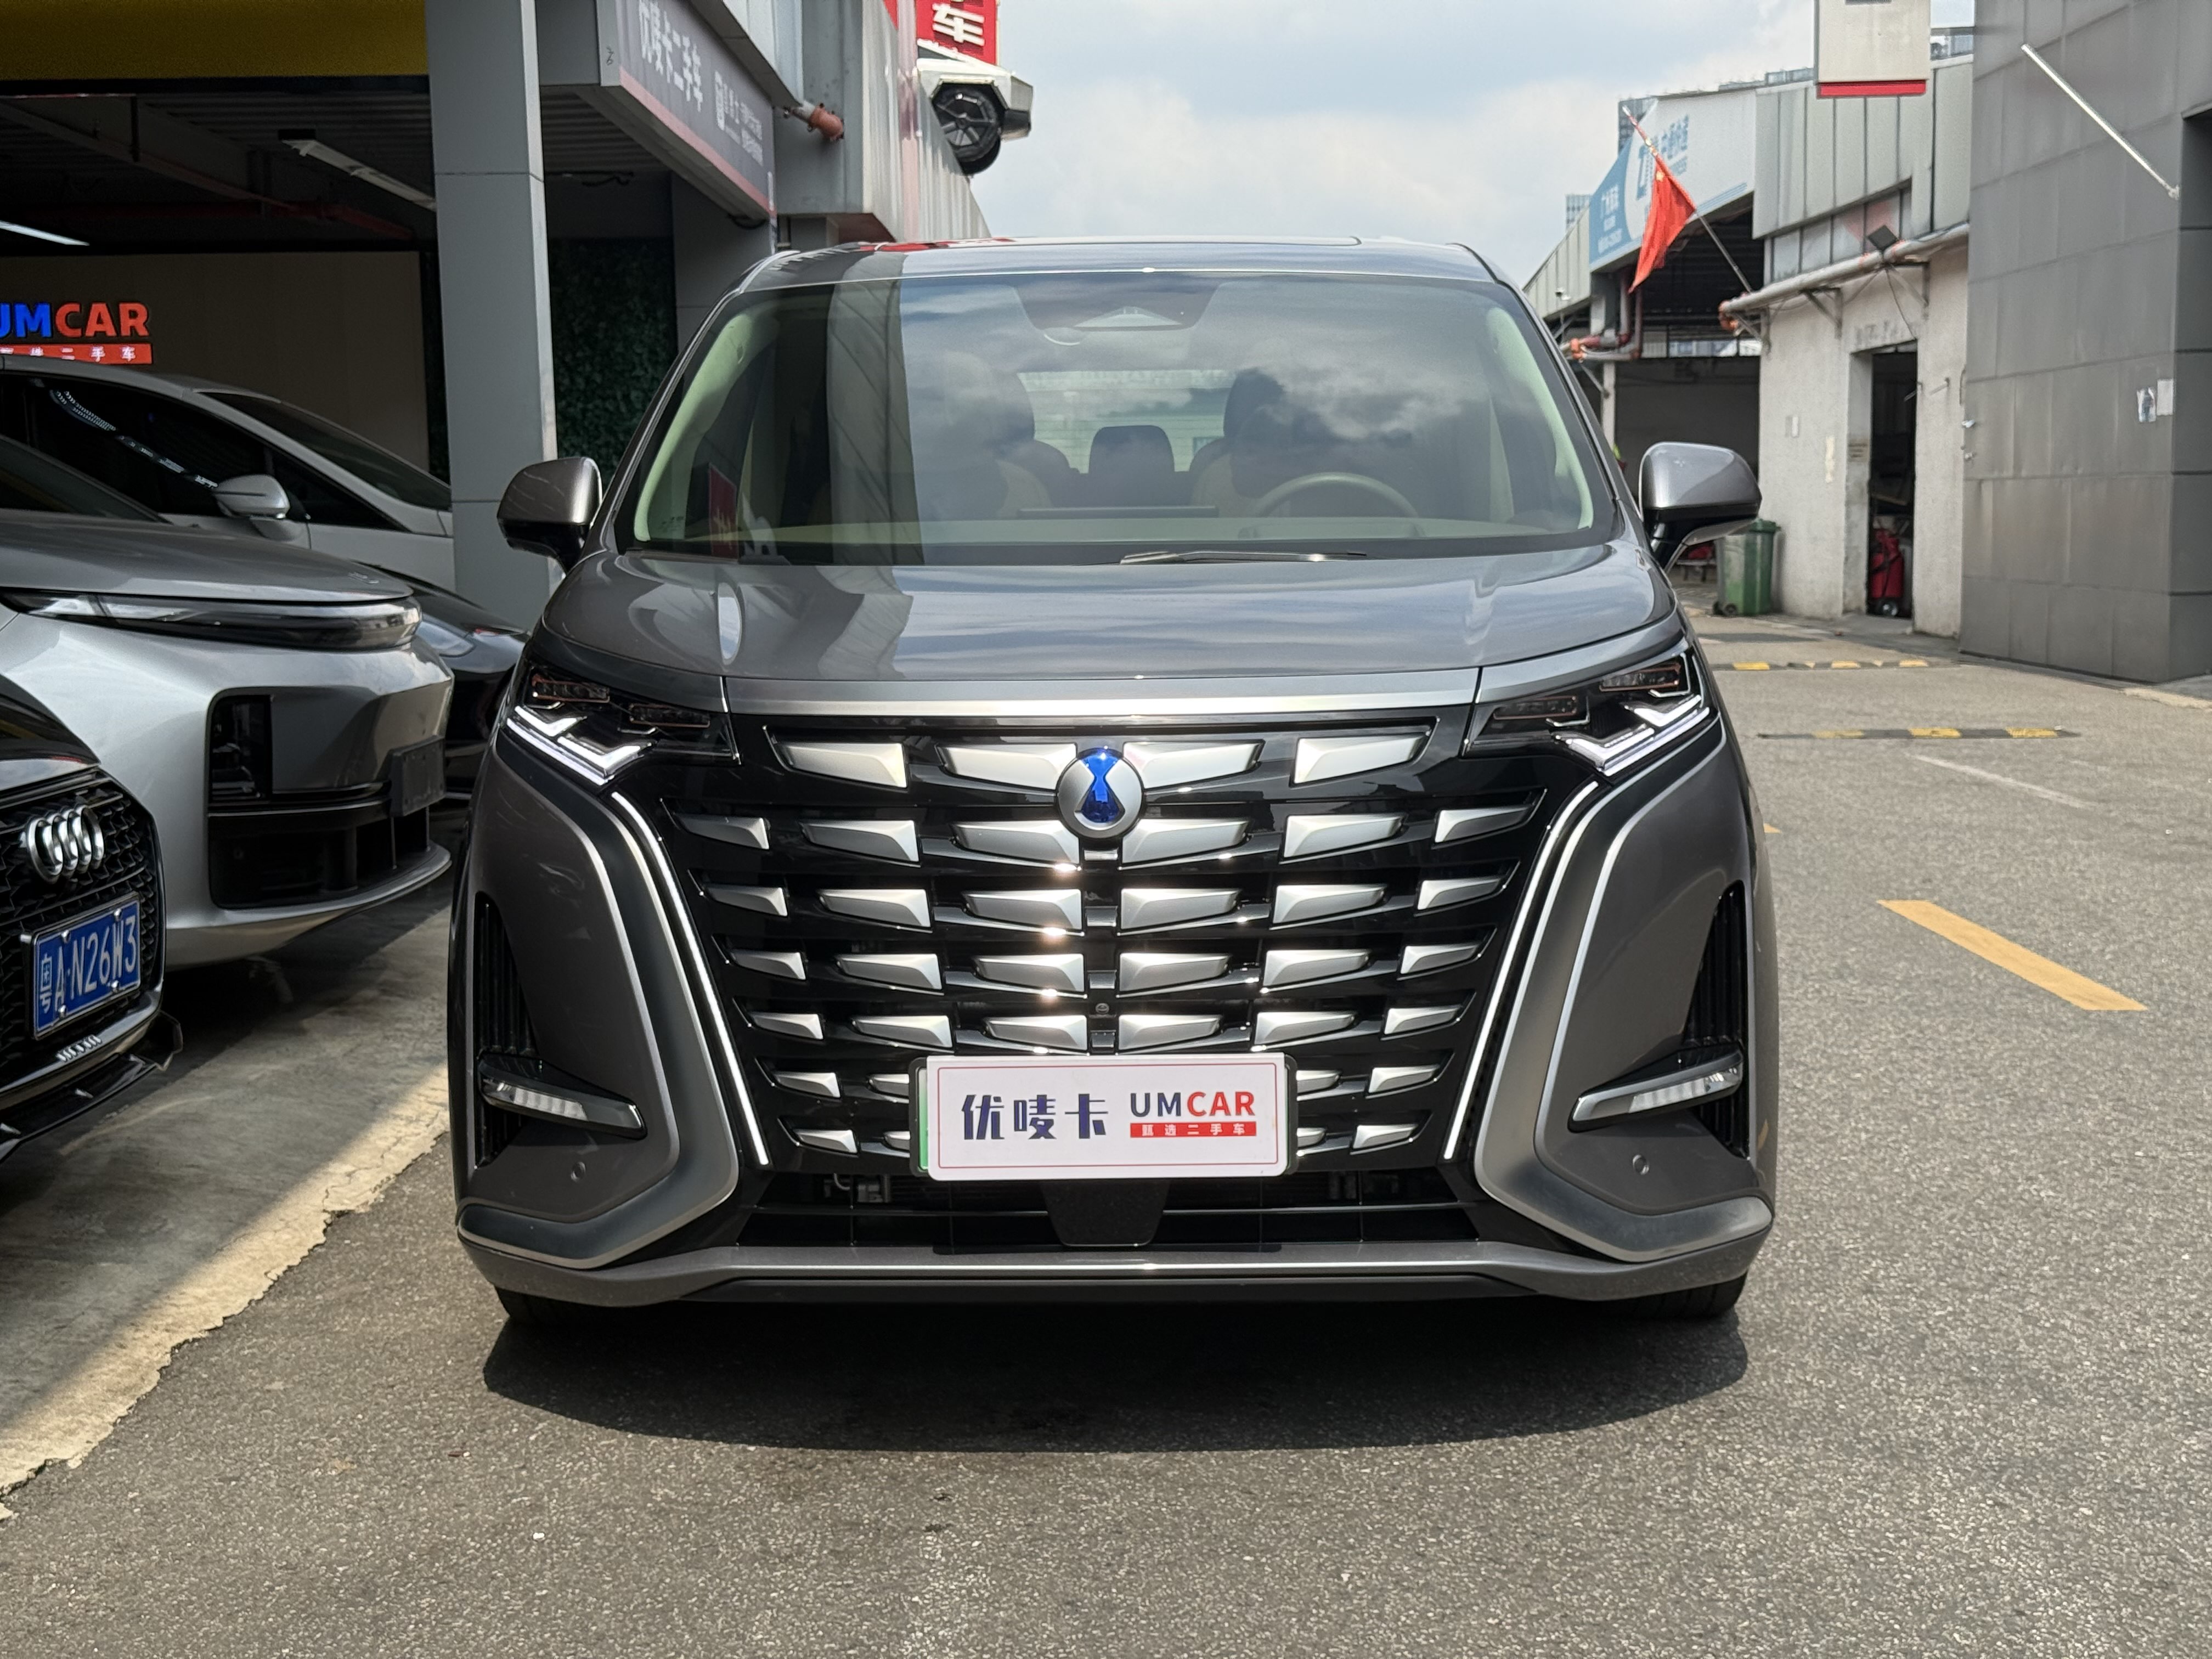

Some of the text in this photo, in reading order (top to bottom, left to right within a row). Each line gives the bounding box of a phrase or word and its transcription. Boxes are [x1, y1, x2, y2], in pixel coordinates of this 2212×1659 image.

[932, 3, 985, 47] 车
[961, 1093, 1108, 1139] 优唛卡
[1130, 1092, 1255, 1118] UMCAR
[1142, 1124, 1245, 1136] 甄选二手车
